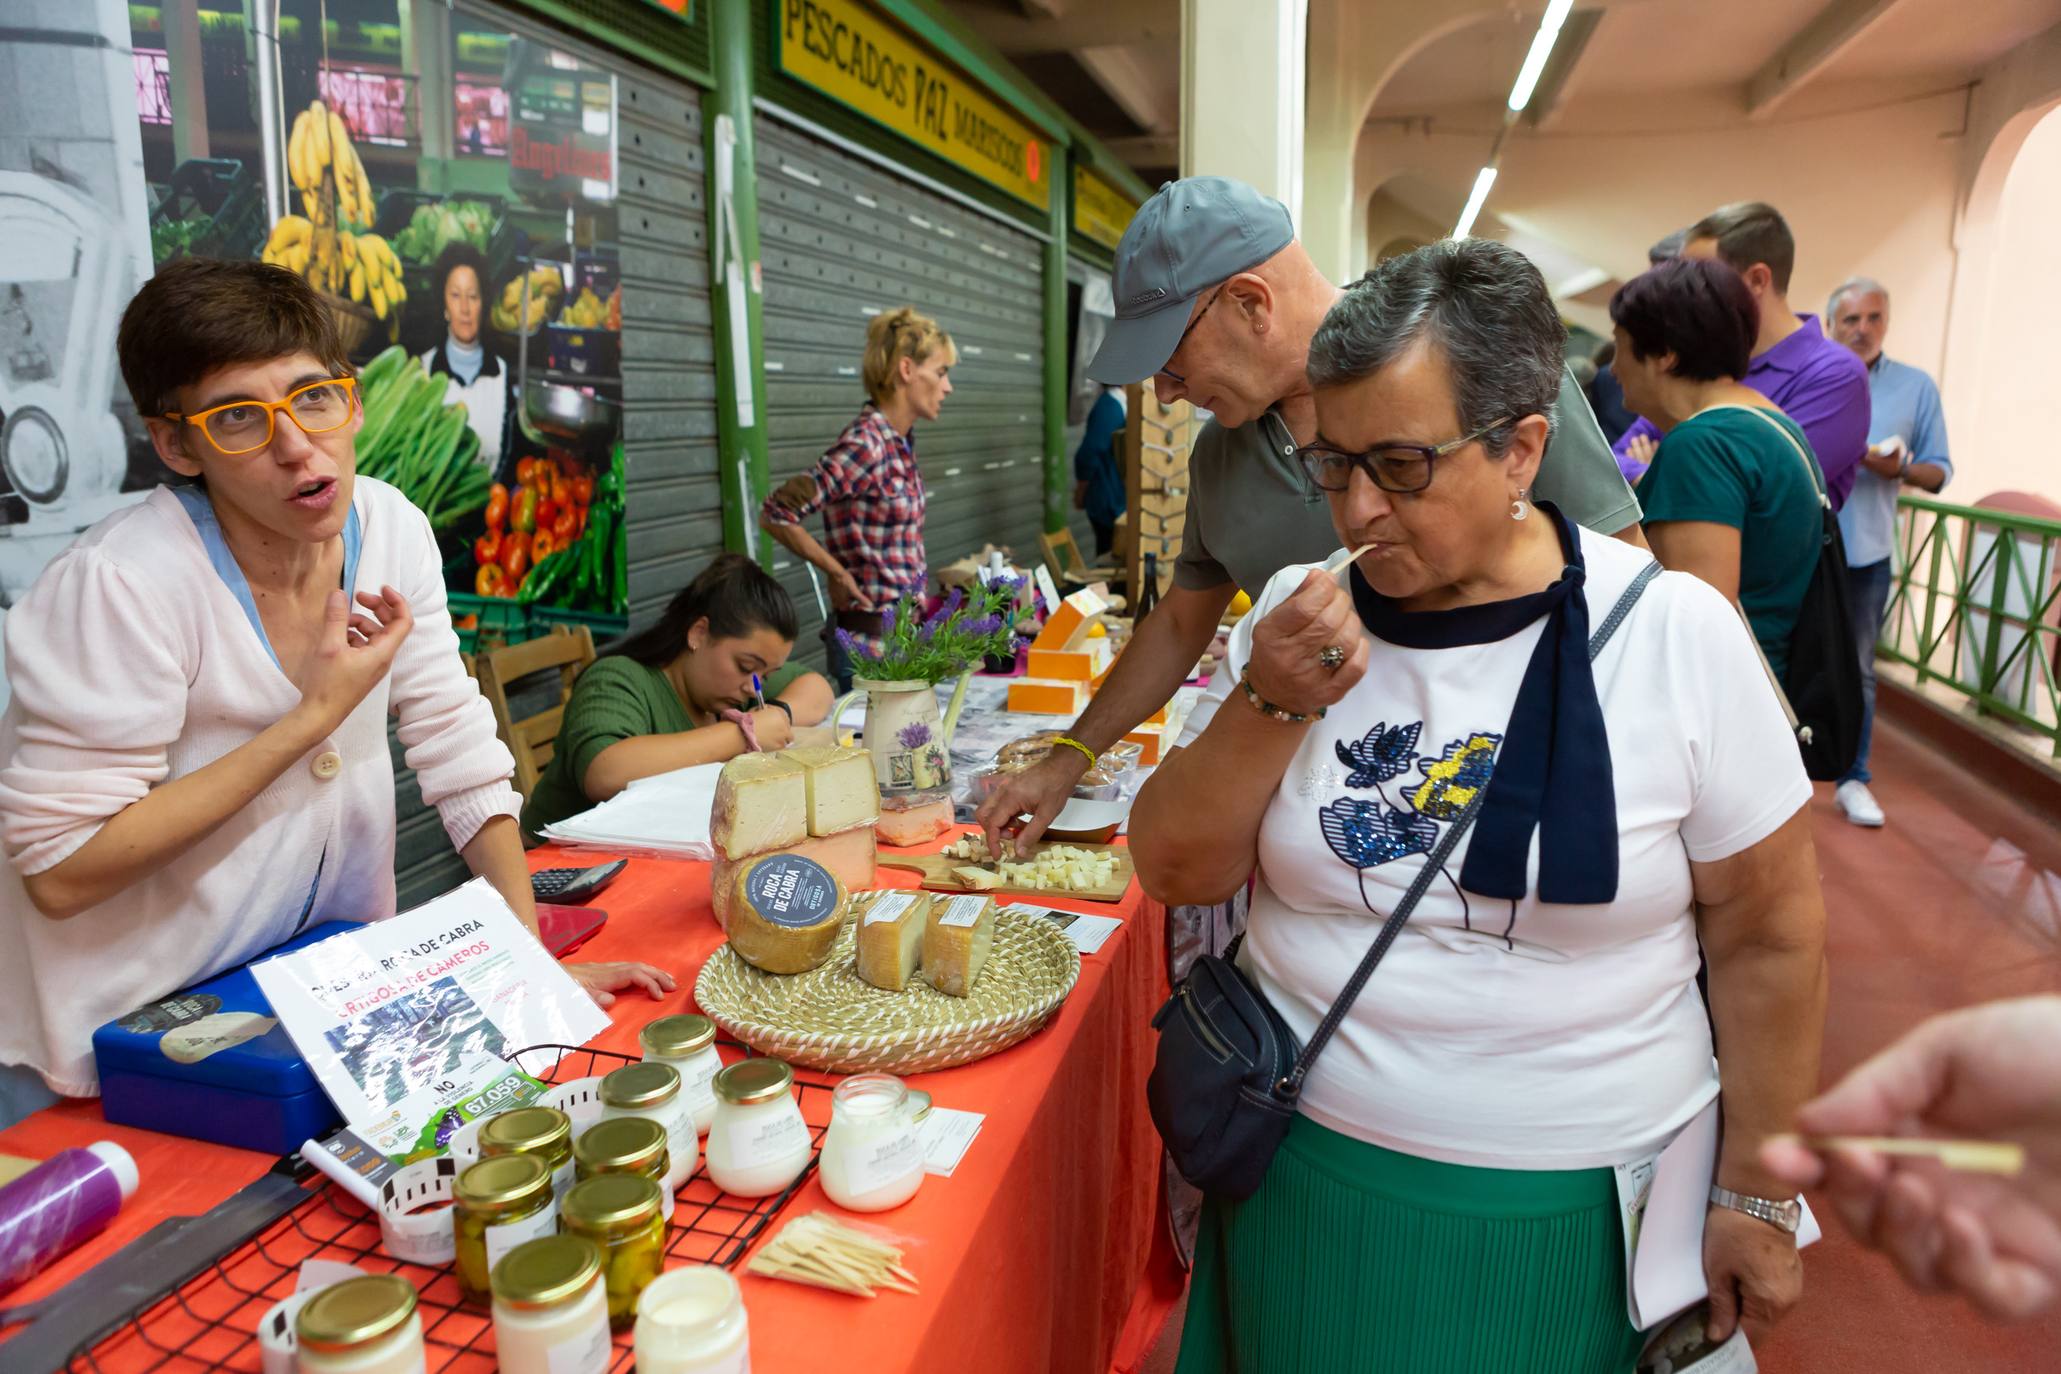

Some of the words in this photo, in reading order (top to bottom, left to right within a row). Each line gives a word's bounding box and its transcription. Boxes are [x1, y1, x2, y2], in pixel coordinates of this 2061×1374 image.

[786, 0, 907, 109] PESCADOS
[914, 64, 948, 142] PAZ
[761, 873, 783, 898] ROCA
[778, 869, 801, 900] CABRA
[773, 898, 789, 912] DE
[419, 938, 440, 955] DE
[439, 919, 485, 945] CABRA
[426, 940, 490, 977] CAMEROS
[433, 1080, 456, 1094] NO
[465, 1076, 521, 1114] 67.059
